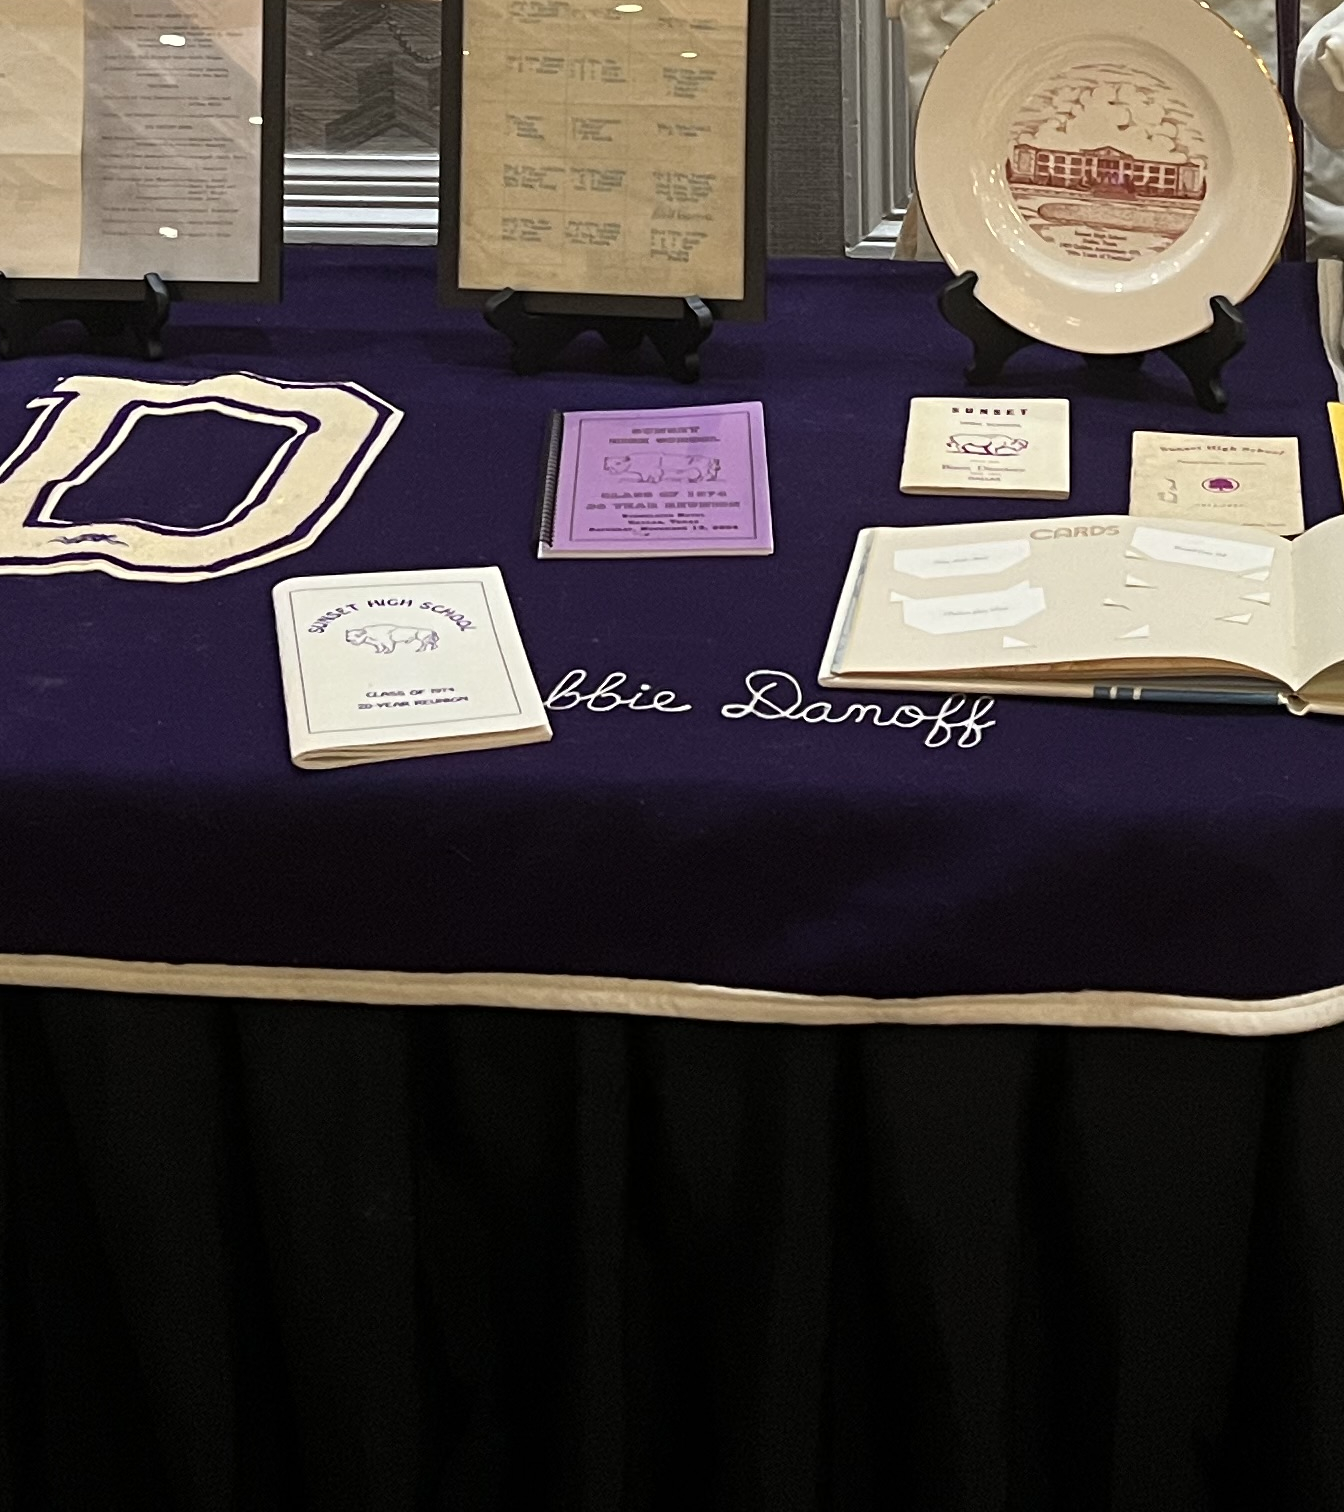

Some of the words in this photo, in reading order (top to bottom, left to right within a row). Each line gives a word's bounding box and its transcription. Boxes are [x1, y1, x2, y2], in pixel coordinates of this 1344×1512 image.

[952, 407, 1028, 416] SUNSET
[1029, 524, 1120, 541] CARDS
[308, 603, 360, 634] SUNSET
[367, 598, 413, 608] HIGH
[419, 601, 478, 632] SCHOOL
[365, 690, 406, 699] CLASS
[546, 669, 692, 713] bbie
[721, 669, 997, 749] Danoff
